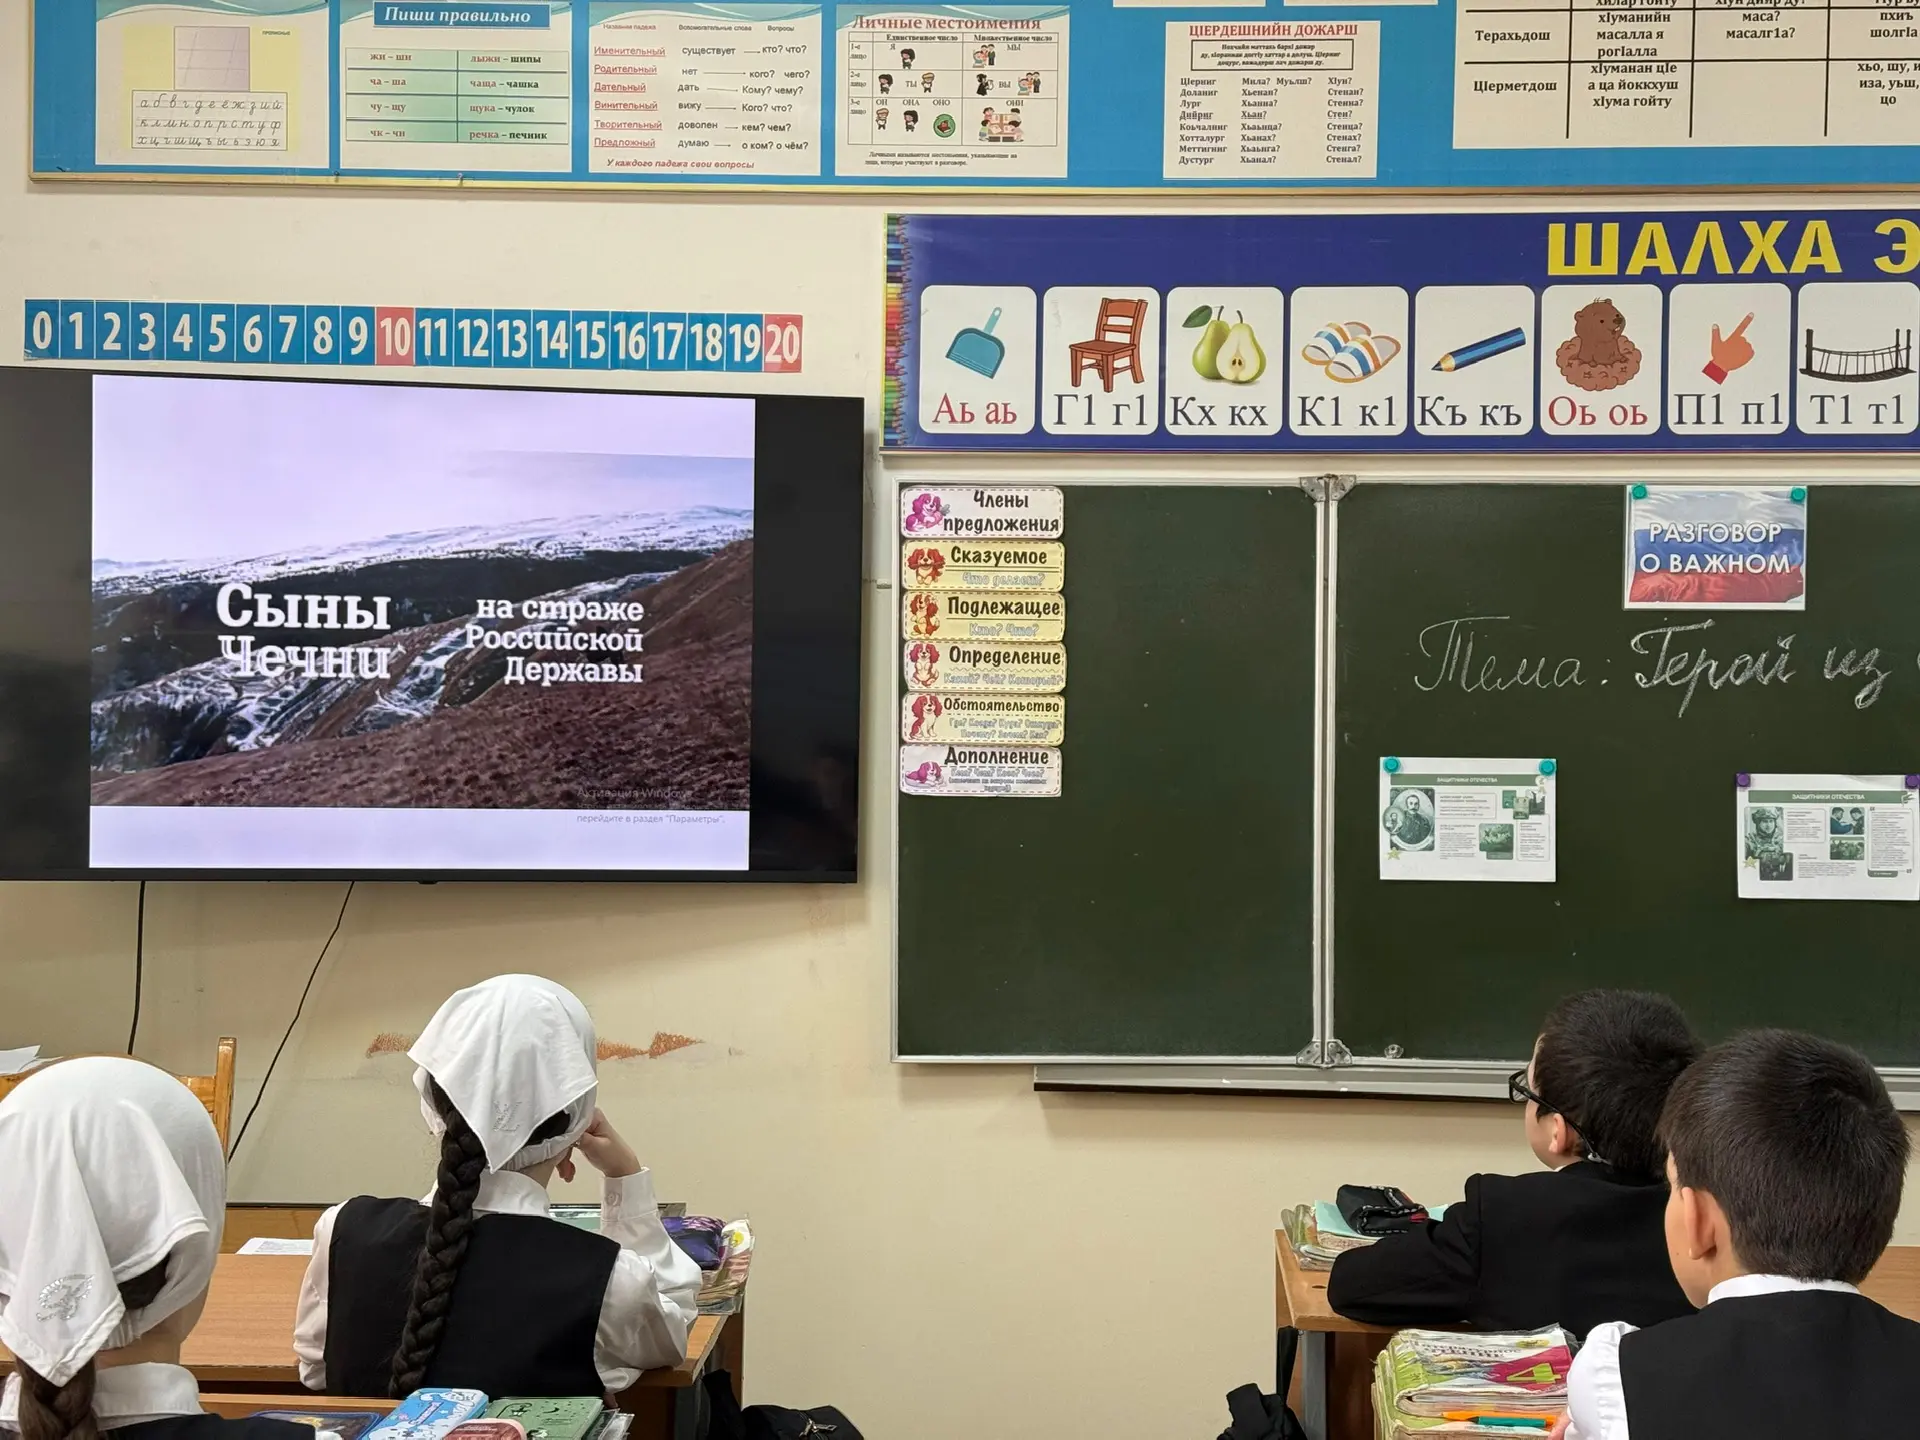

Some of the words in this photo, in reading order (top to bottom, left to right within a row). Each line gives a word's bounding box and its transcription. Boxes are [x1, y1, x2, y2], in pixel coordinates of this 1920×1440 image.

[385, 7, 435, 21] Пиши
[439, 11, 531, 25] правильно
[852, 15, 925, 30] Личные
[926, 19, 1042, 30] местоимения
[1742, 11, 1781, 22] маса?
[1880, 12, 1913, 21] пхиъ
[1294, 24, 1358, 38] ДОЖАРШ
[1475, 30, 1550, 43] Терахьдош
[1596, 30, 1653, 40] масалла
[370, 53, 386, 61] жи
[594, 46, 665, 56] Именительный
[682, 47, 736, 56] существует
[762, 45, 783, 54] кто?
[786, 45, 807, 54] что?
[470, 55, 500, 64] лыжи
[510, 56, 541, 64] шипы
[594, 65, 658, 75] Родительный
[750, 70, 775, 79] кого?
[784, 71, 810, 79] чего?
[1857, 62, 1884, 74] хьо,
[1887, 62, 1910, 74] шу,
[370, 78, 382, 86] ча
[392, 78, 406, 86] ша
[470, 80, 497, 89] чаща
[506, 81, 539, 89] чашка
[1242, 77, 1270, 85] Мила?
[1598, 82, 1615, 93] ца
[1618, 78, 1678, 93] йоккхуш
[1859, 79, 1886, 90] иза,
[1889, 79, 1920, 90] уьш,
[594, 83, 646, 92] Дательный
[678, 84, 699, 92] дать
[742, 86, 771, 95] Кому?
[774, 86, 803, 96] чему?
[1180, 89, 1218, 97] Доланиг
[1241, 88, 1278, 96] Хьенан?
[1328, 88, 1364, 96] Стенан?
[594, 101, 658, 110] Винительный
[678, 102, 702, 112] вижу
[742, 104, 768, 113] Кого?
[771, 104, 792, 113] что?
[1180, 100, 1201, 109] Лург
[1327, 99, 1363, 107] Стенна?
[1634, 95, 1672, 109] гойту
[1880, 96, 1897, 106] цо
[370, 104, 383, 113] чу
[392, 104, 406, 113] щу
[470, 105, 496, 114] щука
[505, 105, 535, 114] чулок
[1241, 111, 1267, 119] Хьан?
[1327, 110, 1353, 118] Стен?
[594, 120, 662, 130] Творительный
[678, 121, 718, 130] доволен
[742, 123, 765, 132] кем?
[768, 123, 792, 132] чем?
[1327, 123, 1363, 132] Стенца?
[370, 129, 383, 137] чк
[392, 129, 406, 138] чн
[469, 131, 499, 140] речка
[509, 131, 547, 140] печник
[1179, 134, 1225, 143] Хотталург
[1241, 134, 1276, 142] Хьанах?
[1327, 133, 1362, 142] Стенах?
[594, 138, 656, 148] Предложный
[678, 139, 710, 149] думаю
[751, 141, 774, 150] ком?
[785, 141, 809, 150] чём?
[1326, 145, 1361, 153] Стенга?
[615, 160, 653, 168] каждого
[655, 160, 688, 169] падежа
[690, 161, 712, 169] свои
[714, 162, 754, 170] вопросы
[1179, 156, 1214, 166] Дустург
[1240, 156, 1276, 164] Хьанал?
[1326, 155, 1362, 164] Стенал?
[1547, 219, 1843, 276] ШАЛХА
[33, 311, 53, 350] 0
[69, 312, 82, 350] 1
[103, 312, 122, 351] 2
[138, 313, 156, 351] 3
[173, 314, 193, 352] 4
[208, 315, 227, 352] 5
[243, 315, 263, 353] 6
[279, 316, 298, 353] 7
[313, 316, 333, 355] 8
[348, 316, 367, 355] 9
[380, 317, 411, 356] 10
[419, 318, 447, 357] 11
[458, 319, 489, 358] 12
[497, 319, 528, 358] 13
[536, 320, 568, 358] 14
[575, 321, 606, 360] 15
[613, 322, 646, 360] 16
[652, 323, 684, 361] 17
[691, 324, 723, 362] 18
[729, 324, 761, 363] 19
[765, 324, 800, 364] 20
[932, 393, 975, 425] Аь
[985, 400, 1017, 425] аь
[1169, 396, 1217, 427] Кх
[1229, 404, 1267, 427] кх
[1417, 396, 1467, 427] Къ
[1480, 404, 1522, 427] къ
[1549, 397, 1596, 427] Оь
[1609, 403, 1648, 426] оь
[974, 490, 1029, 508] Члены
[943, 518, 1059, 535] предложения
[1649, 522, 1783, 543] РАЗГОВОР
[951, 546, 1047, 567] Сказуемое
[1640, 553, 1662, 573] О
[1670, 553, 1791, 575] ВАЖНОМ
[216, 582, 391, 630] Сыны
[477, 598, 514, 620] на
[522, 600, 644, 626] страже
[948, 597, 1060, 618] Подлежащее
[465, 624, 644, 653] Российской
[218, 635, 390, 679] Чечни
[950, 646, 1061, 668] Определение
[504, 658, 644, 686] Державы
[1631, 618, 1797, 717] Герой
[1823, 646, 1892, 709] из
[944, 698, 1059, 713] Обстоятельство
[944, 747, 1049, 766] Дополнение
